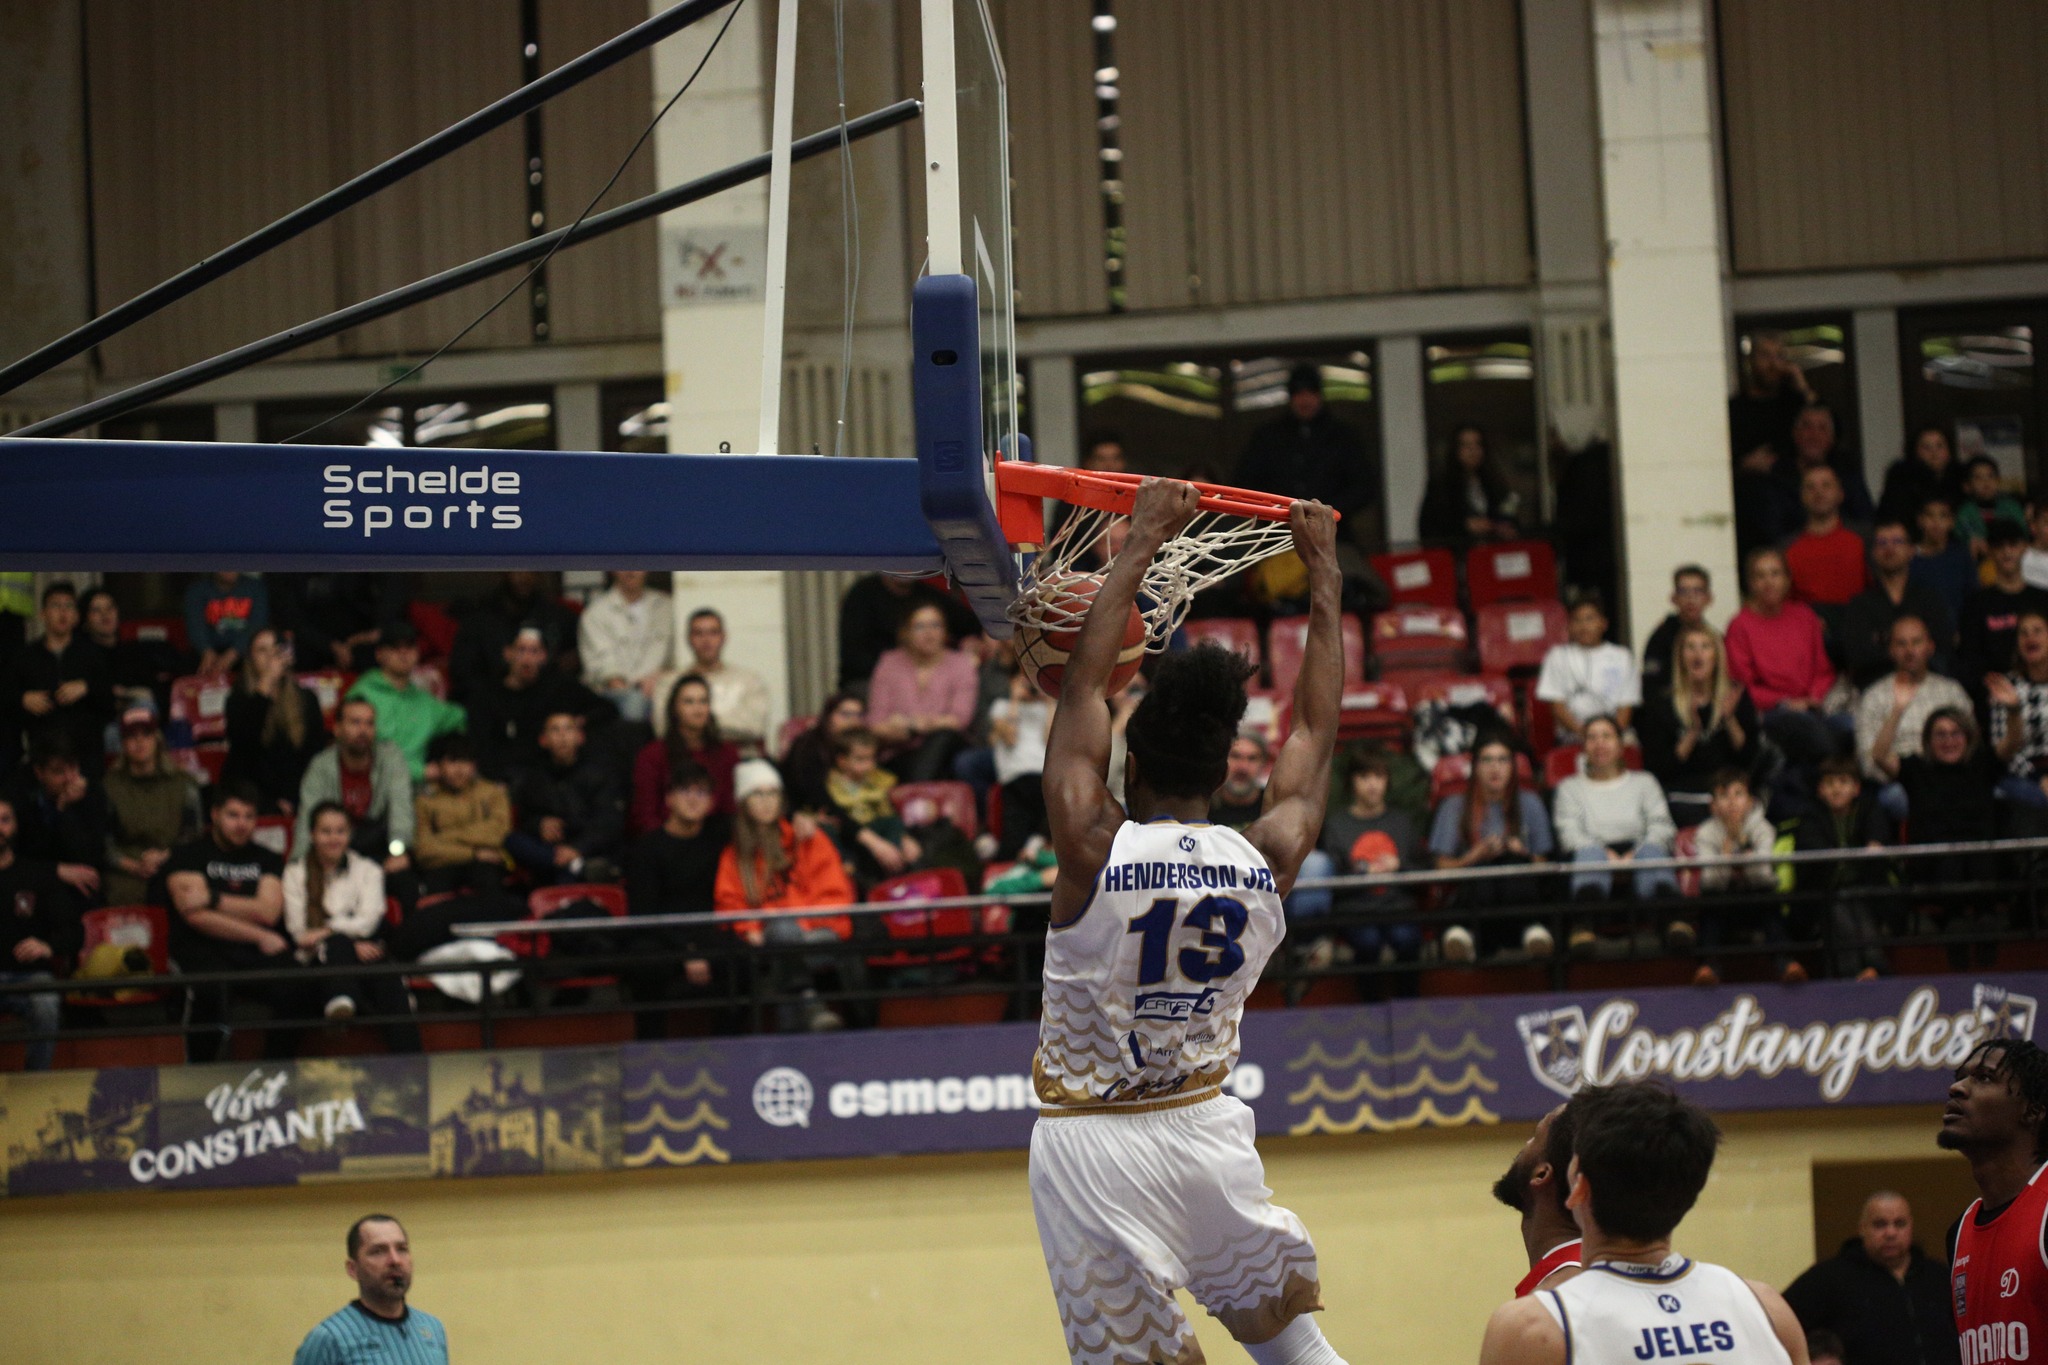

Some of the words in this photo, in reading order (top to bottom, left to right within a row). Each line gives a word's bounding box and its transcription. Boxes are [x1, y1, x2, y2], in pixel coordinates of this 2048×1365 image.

[323, 464, 520, 494] Schelde
[323, 499, 523, 537] Sports
[1105, 862, 1237, 892] HENDERSON
[1127, 893, 1249, 987] 13
[1582, 988, 1984, 1100] Constangeles
[205, 1067, 288, 1125] Visit
[1634, 1320, 1734, 1361] JELES
